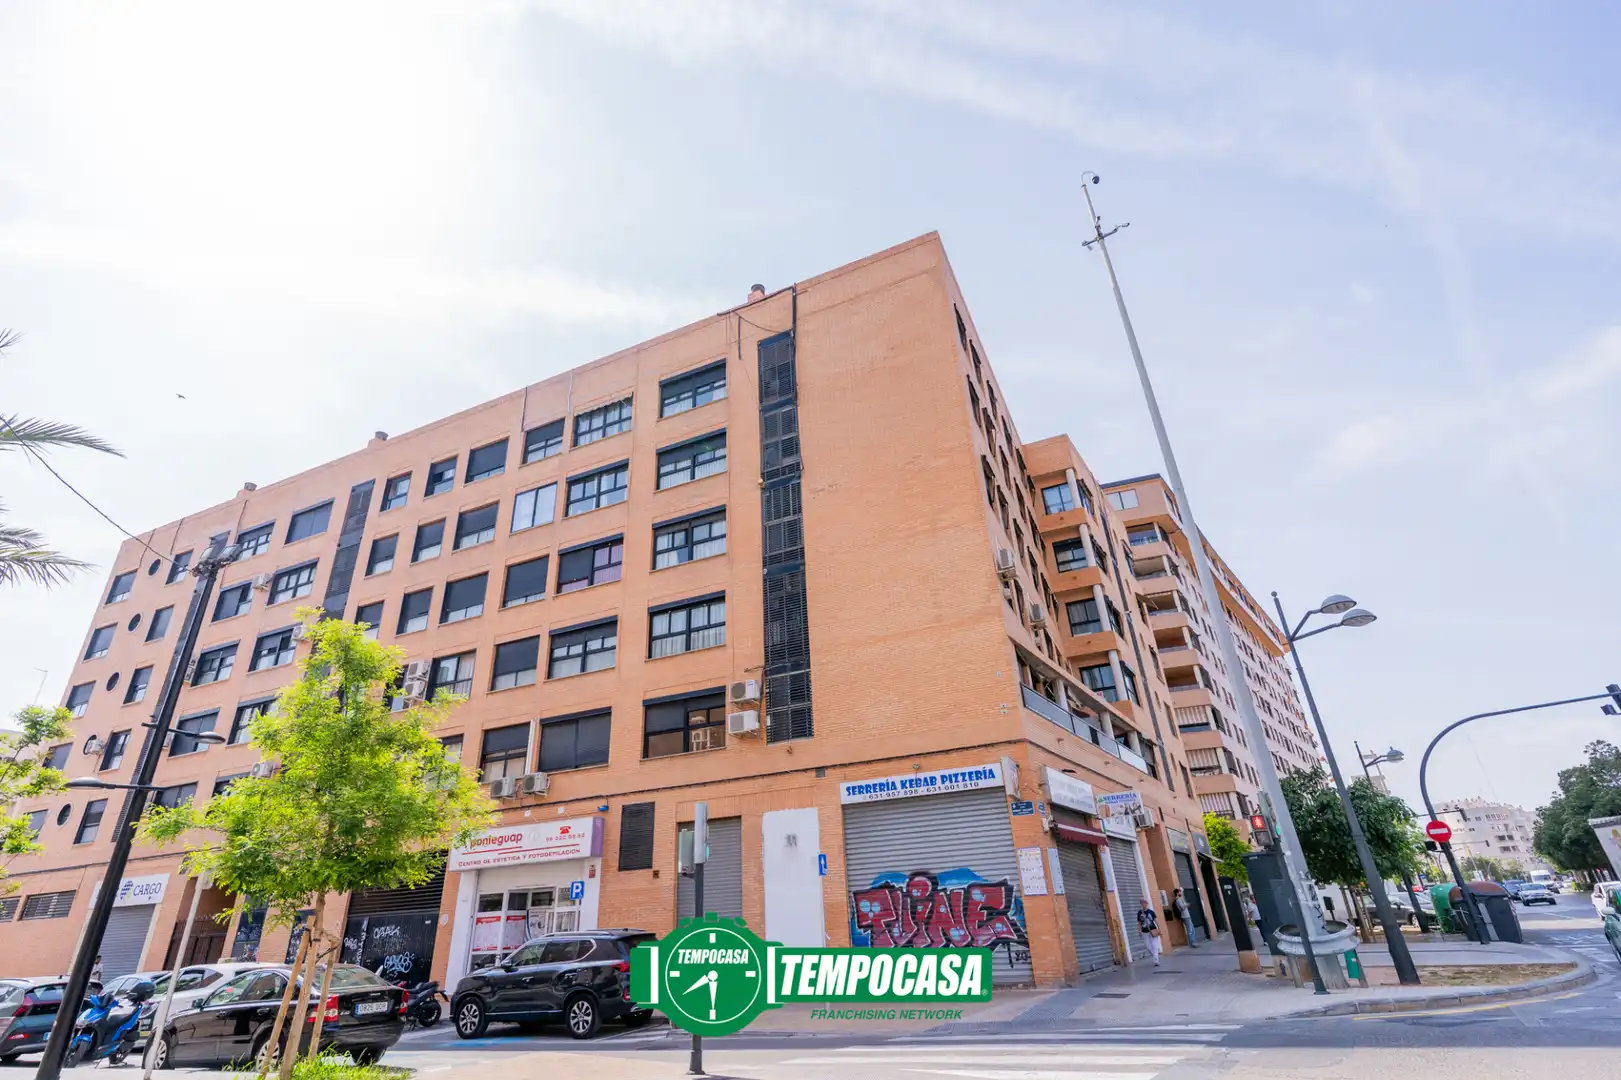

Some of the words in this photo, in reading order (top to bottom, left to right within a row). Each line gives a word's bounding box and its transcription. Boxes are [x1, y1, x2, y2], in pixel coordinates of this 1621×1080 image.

[845, 778, 898, 796] SERRERÍA
[900, 774, 937, 790] KEBAB
[940, 766, 996, 784] PIZZERÍA
[133, 882, 162, 896] CARGO
[573, 882, 582, 899] P
